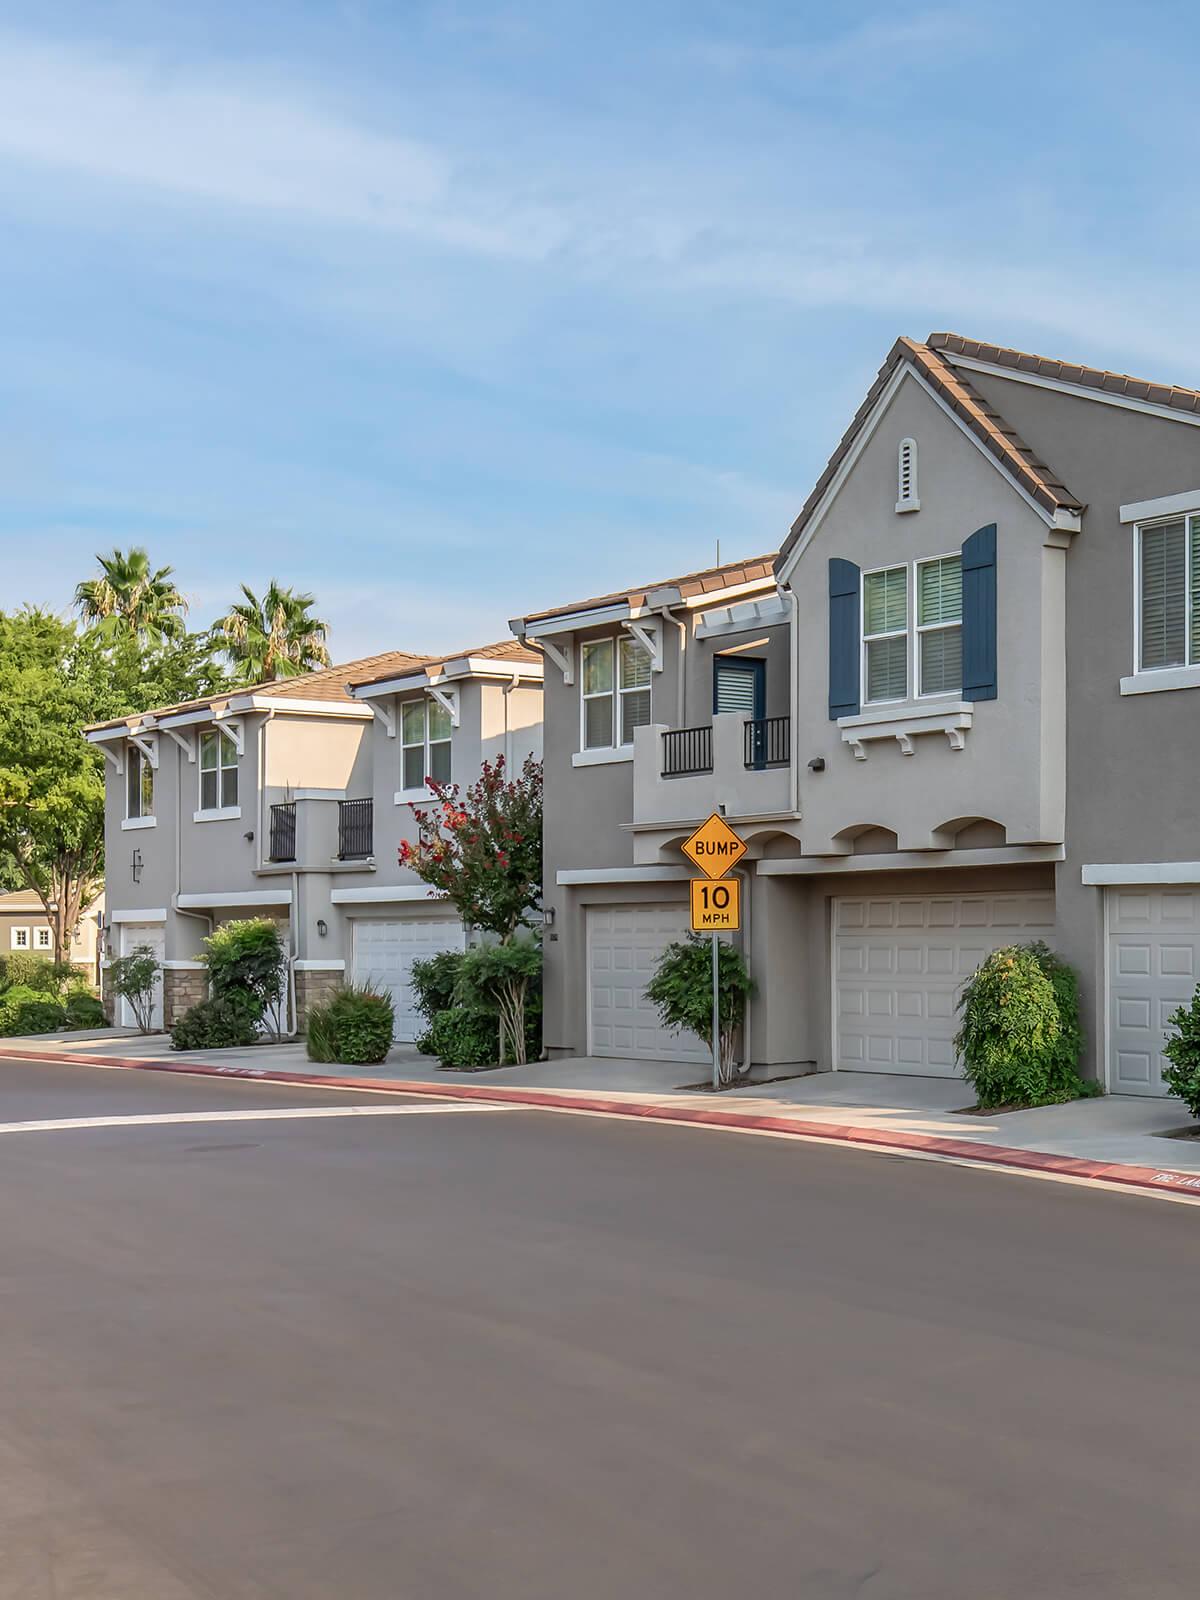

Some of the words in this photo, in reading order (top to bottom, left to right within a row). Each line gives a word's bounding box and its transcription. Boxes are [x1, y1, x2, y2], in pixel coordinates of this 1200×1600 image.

[695, 841, 739, 855] BUMP
[701, 886, 730, 909] 10
[702, 913, 730, 923] MPH
